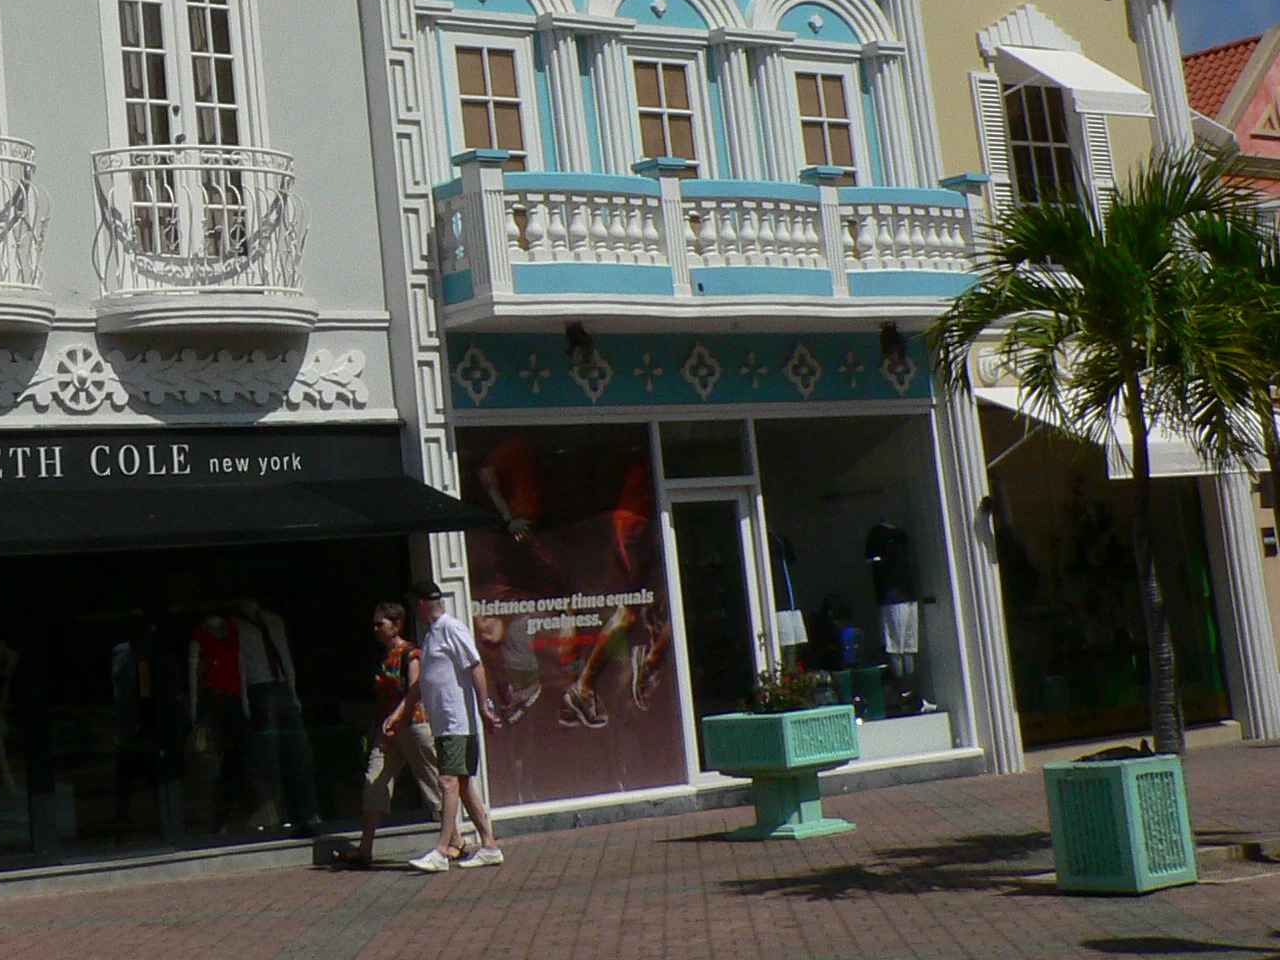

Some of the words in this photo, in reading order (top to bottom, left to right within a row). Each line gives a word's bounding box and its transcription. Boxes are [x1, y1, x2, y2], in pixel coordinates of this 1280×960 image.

[89, 444, 192, 478] COLE
[208, 455, 249, 473] new
[257, 452, 302, 477] york
[472, 599, 535, 616] Distance
[537, 597, 570, 611] over
[572, 592, 605, 608] time
[606, 589, 654, 608] equals
[527, 612, 603, 635] greatness.
